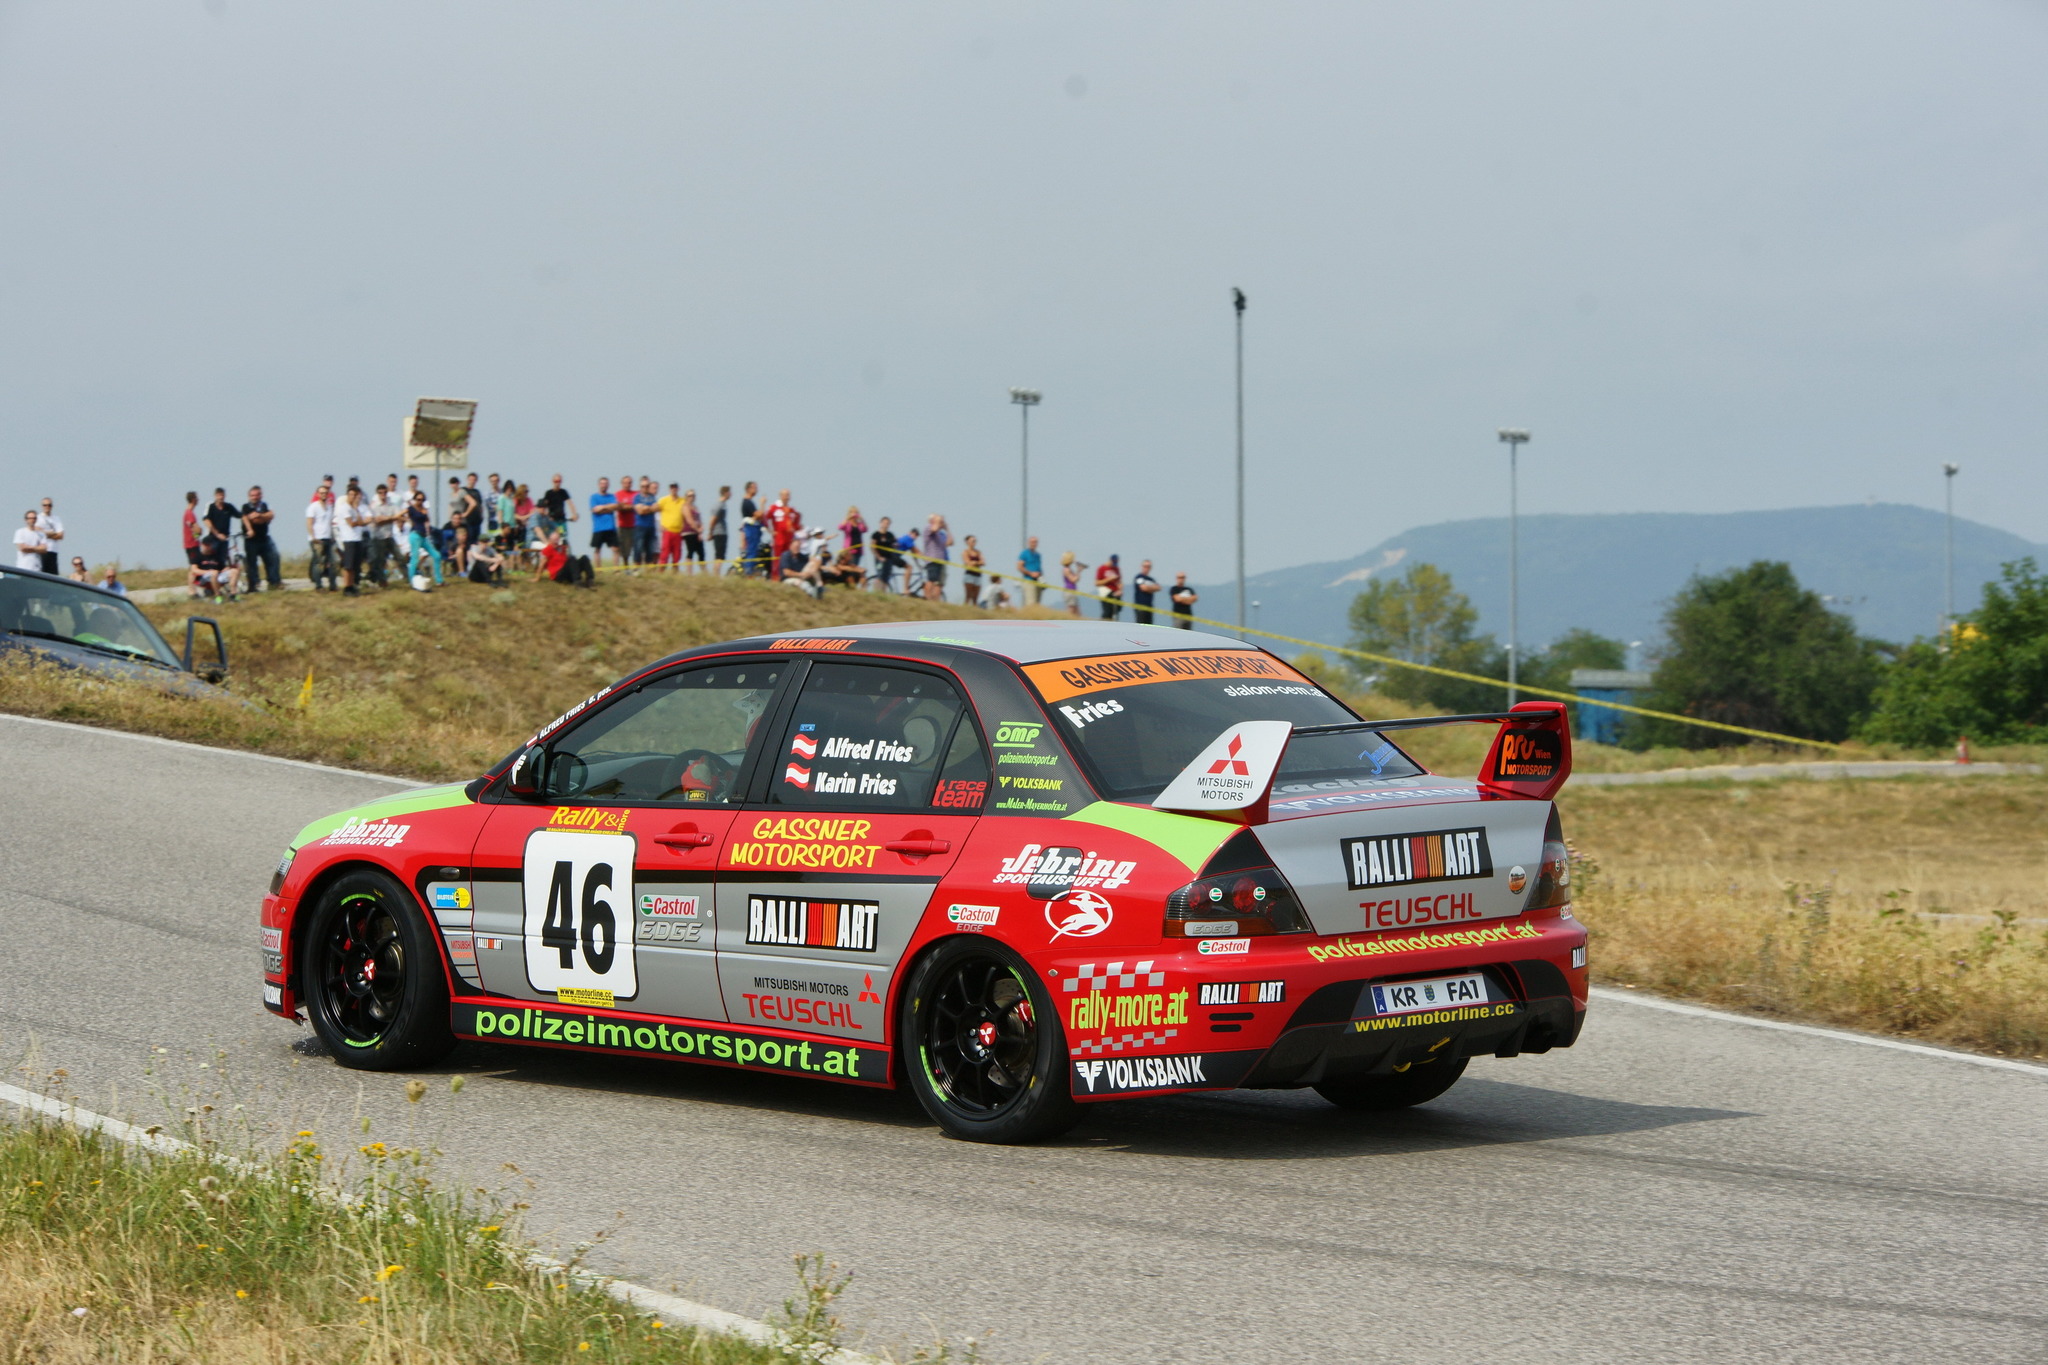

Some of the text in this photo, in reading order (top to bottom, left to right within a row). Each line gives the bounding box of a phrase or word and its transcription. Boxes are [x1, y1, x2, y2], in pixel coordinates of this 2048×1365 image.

[1059, 654, 1282, 689] GASSNER MOTORSPORT
[539, 714, 566, 740] ALFRED
[565, 700, 587, 720] FRIES
[1058, 699, 1125, 729] Fries
[995, 726, 1040, 743] OMP
[821, 737, 914, 763] Alfred Fries
[997, 751, 1059, 767] polizeimotorsport.at
[1506, 764, 1553, 776] MOTORSPORT
[814, 771, 897, 796] Karin Fries
[931, 778, 985, 808] team
[947, 780, 988, 791] race
[1012, 776, 1063, 791] VOLKSBANK
[1196, 777, 1254, 790] MITSUBISHI
[1200, 789, 1244, 802] MOTORS
[1304, 788, 1478, 807] VOLKSBANK
[548, 806, 609, 830] Rally
[616, 809, 631, 831] more
[752, 818, 872, 842] GASSNER
[319, 837, 388, 846] TECHNOLOGY
[328, 816, 411, 847] Sebring
[730, 843, 882, 868] MOTORSPORT
[1000, 843, 1137, 890] Sebring
[1351, 832, 1481, 886] RALLI ART
[992, 873, 1107, 888] SPORTAUSPUFF
[541, 860, 616, 976] 46
[653, 896, 696, 917] Castrol
[959, 906, 995, 923] Castrol
[1359, 892, 1482, 929] TEUSCHL
[637, 920, 704, 942] EDGE
[748, 897, 879, 950] RALLI ART
[955, 923, 985, 933] EDGE
[1192, 923, 1232, 935] EDGE
[1210, 940, 1249, 954] Castrol
[1306, 920, 1543, 963] polizeimotorsport.at
[263, 952, 284, 974] DGE
[559, 988, 613, 998] www.motorline.cc
[754, 977, 849, 997] MITSUBISHI MOTORS
[1200, 981, 1284, 1005] RALLI ART
[1390, 979, 1480, 1009] KR FA1
[743, 993, 863, 1030] TEUSCHL
[1070, 986, 1189, 1036] rally-more.at
[1354, 1002, 1515, 1034] www.motorline.cc
[475, 1008, 860, 1079] polizeimotorsport.at
[1104, 1055, 1207, 1089] VOLKSBANK
